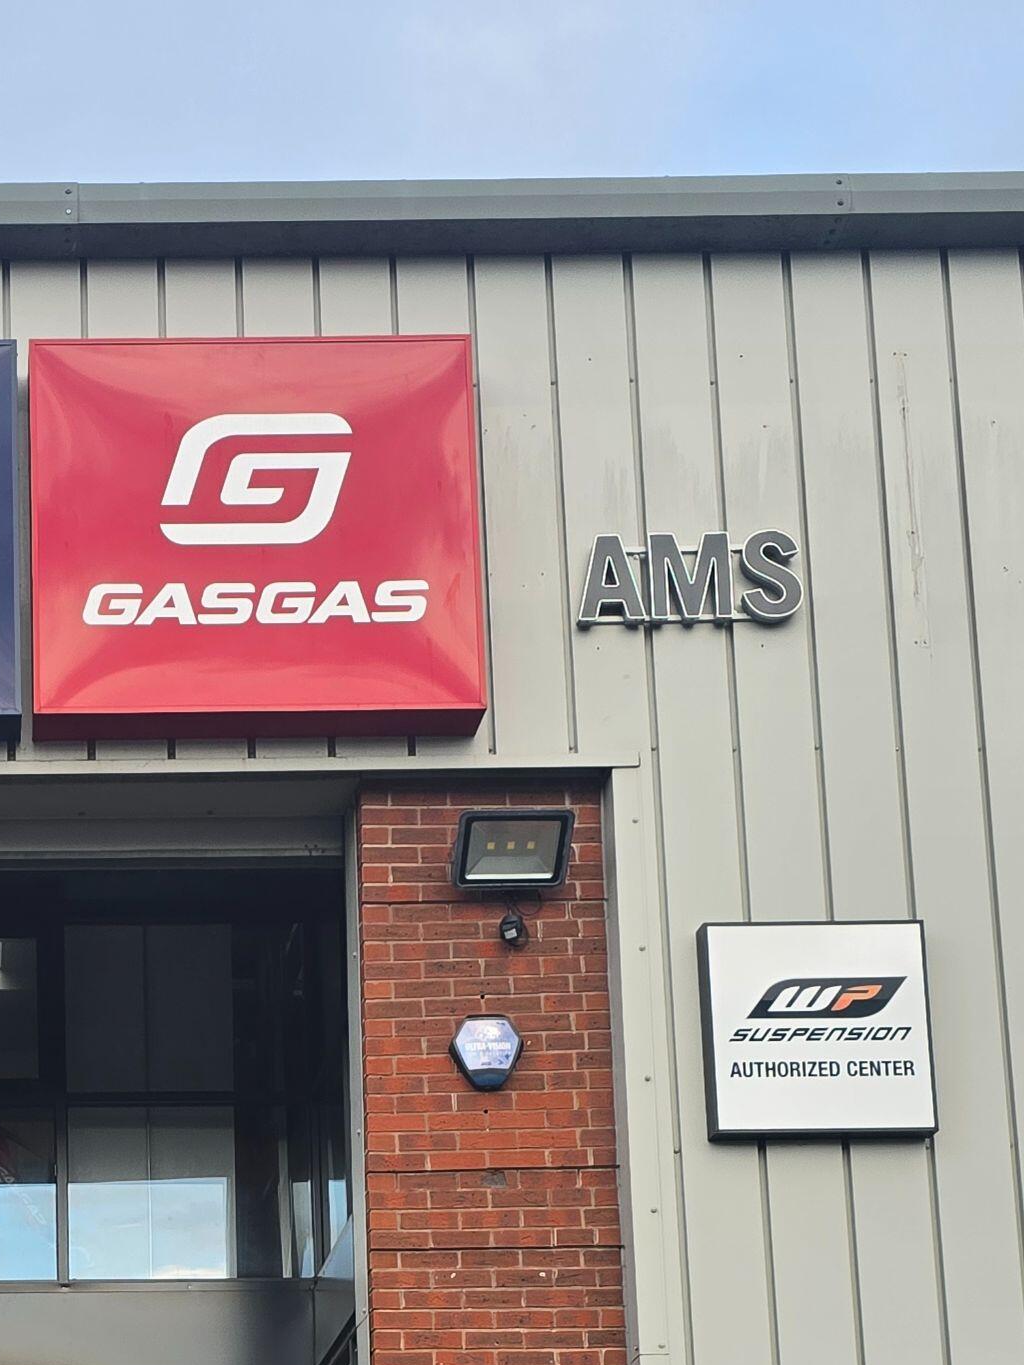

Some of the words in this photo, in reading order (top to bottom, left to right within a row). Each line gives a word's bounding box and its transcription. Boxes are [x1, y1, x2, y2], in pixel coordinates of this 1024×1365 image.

[578, 529, 804, 622] AMS
[82, 579, 430, 626] GASGAS
[767, 984, 882, 1012] WP
[729, 1026, 912, 1042] SUSPENSION
[730, 1060, 841, 1078] AUTHORIZED
[846, 1059, 916, 1077] CENTER
